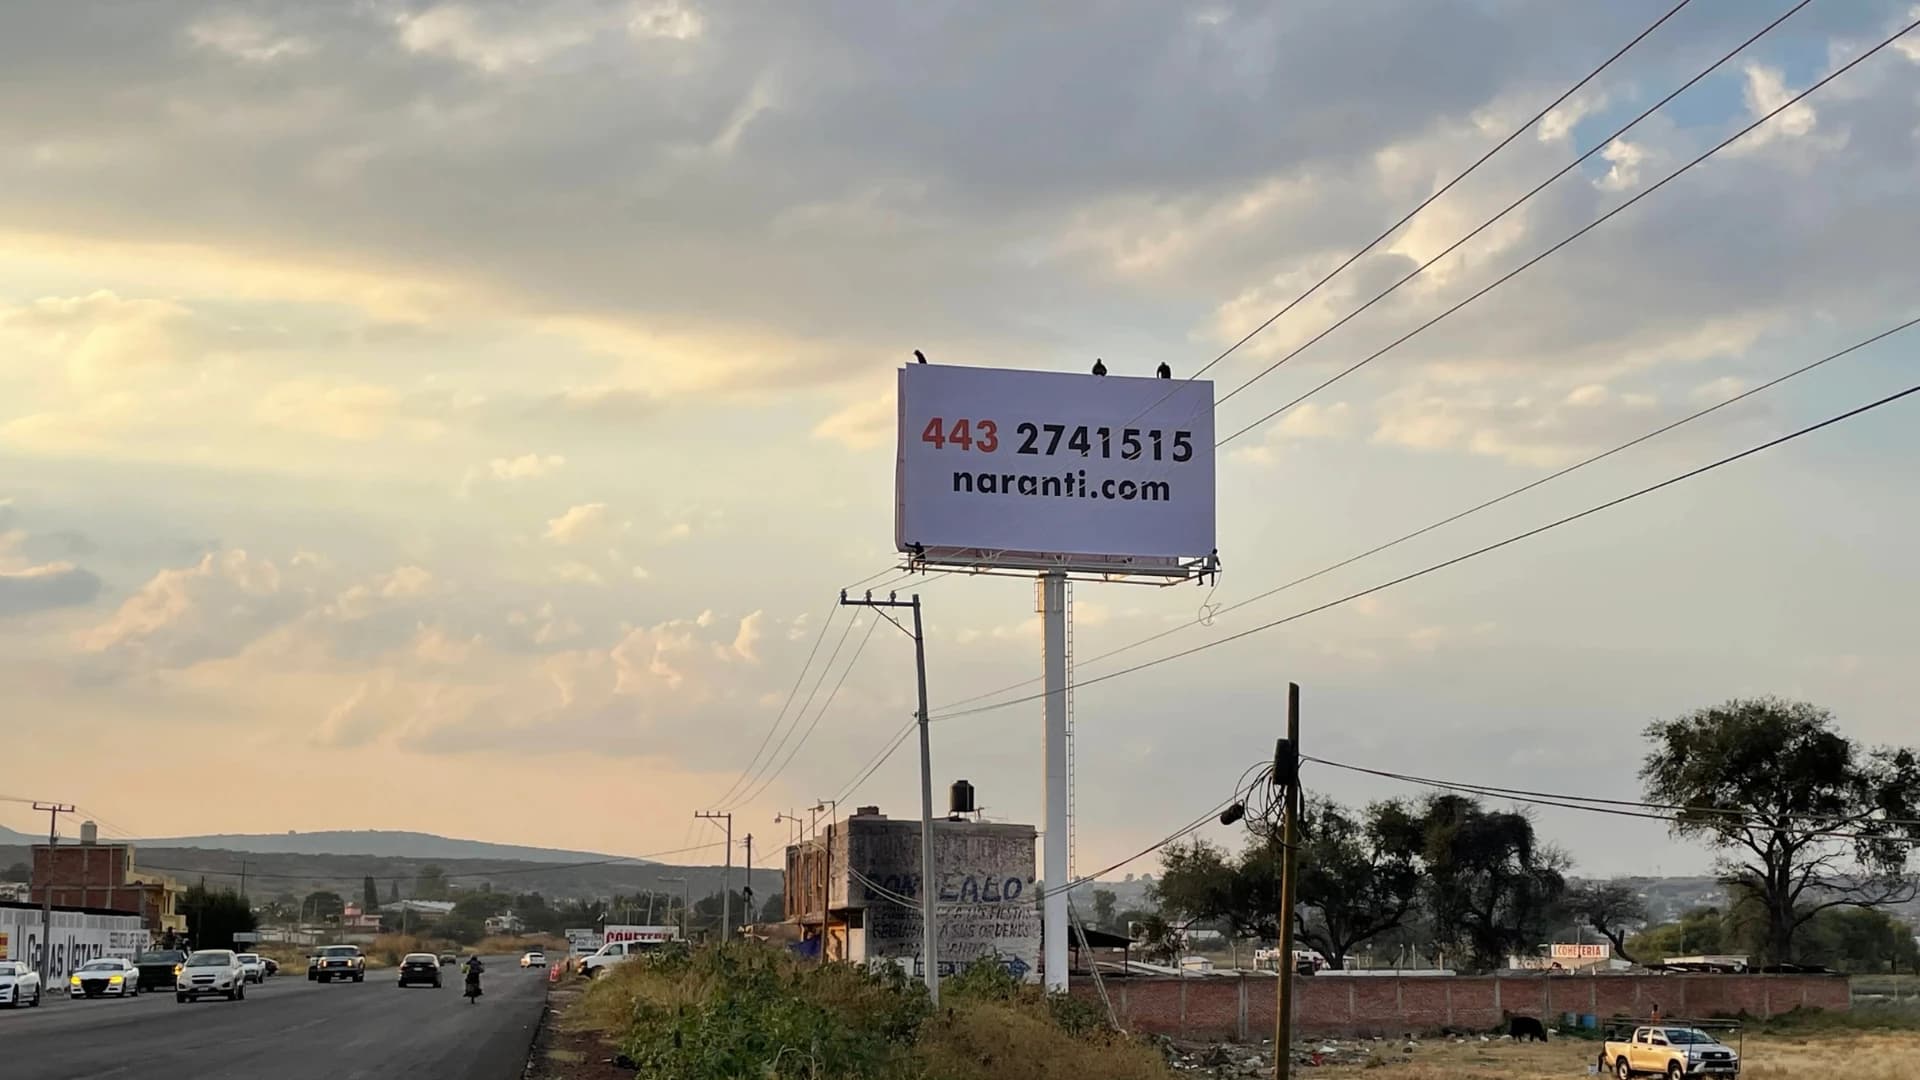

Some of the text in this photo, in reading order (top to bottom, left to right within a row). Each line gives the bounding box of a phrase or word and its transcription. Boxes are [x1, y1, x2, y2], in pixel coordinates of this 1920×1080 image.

[921, 417, 1193, 462] 443 2741515
[953, 469, 1170, 502] naranti.com
[27, 934, 64, 979] GRAS
